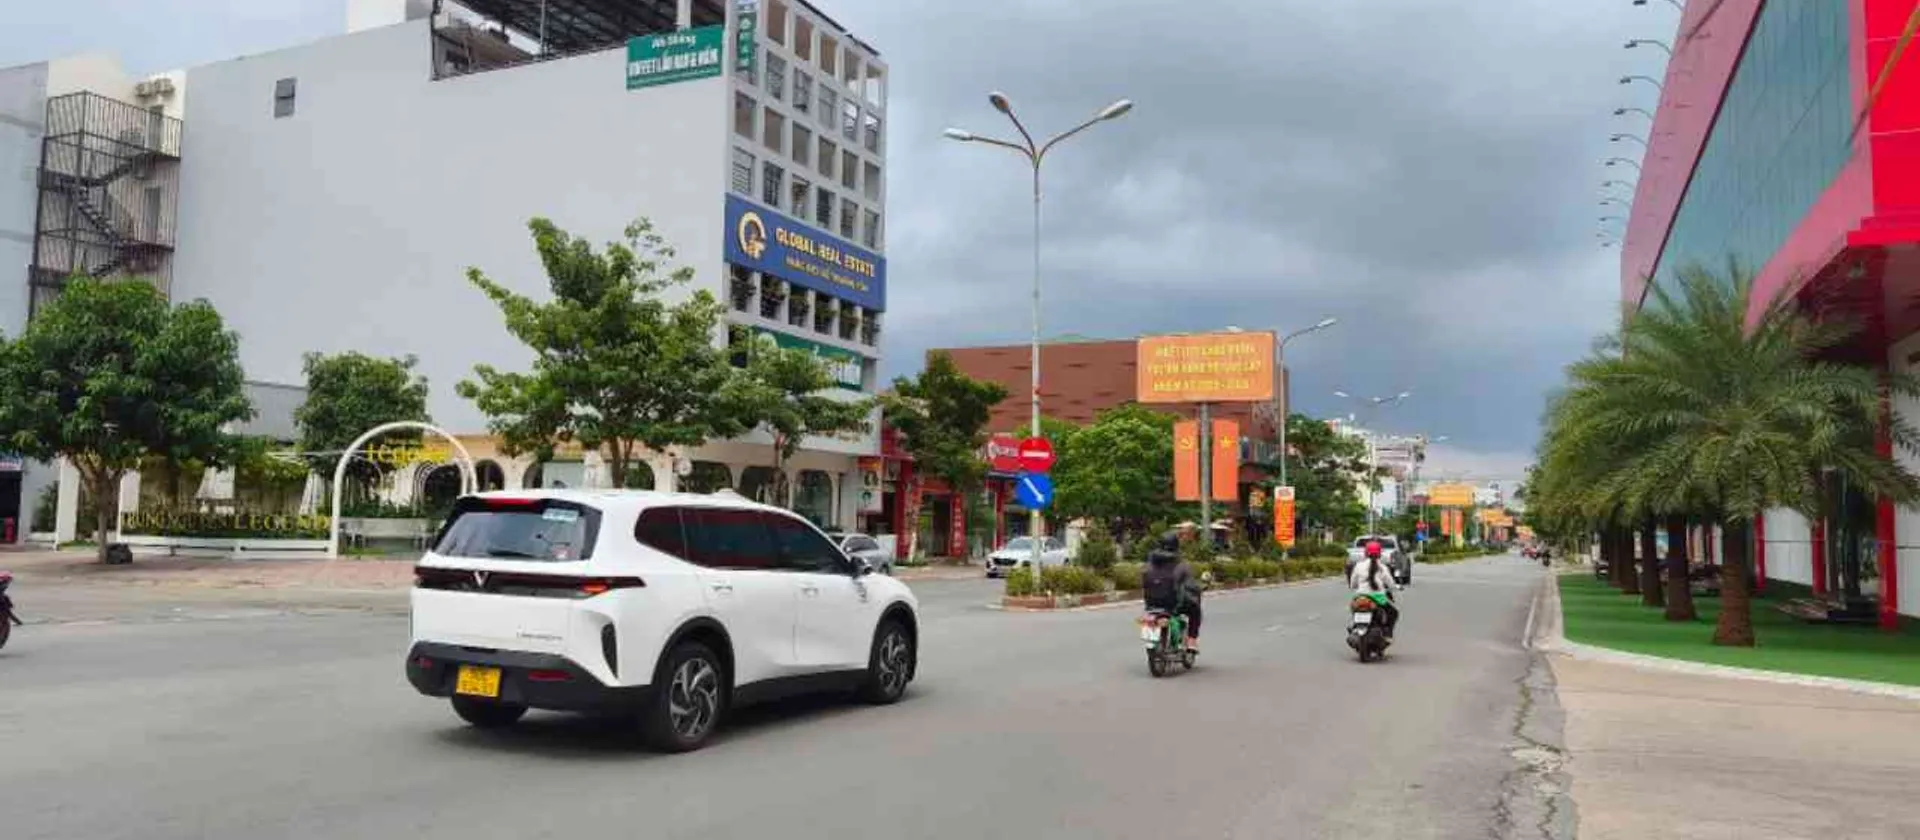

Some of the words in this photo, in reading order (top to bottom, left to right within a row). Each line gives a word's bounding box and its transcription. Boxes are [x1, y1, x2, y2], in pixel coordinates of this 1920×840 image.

[775, 227, 816, 254] GLOBAL
[818, 243, 842, 265] REAL
[844, 254, 876, 278] ESTATE
